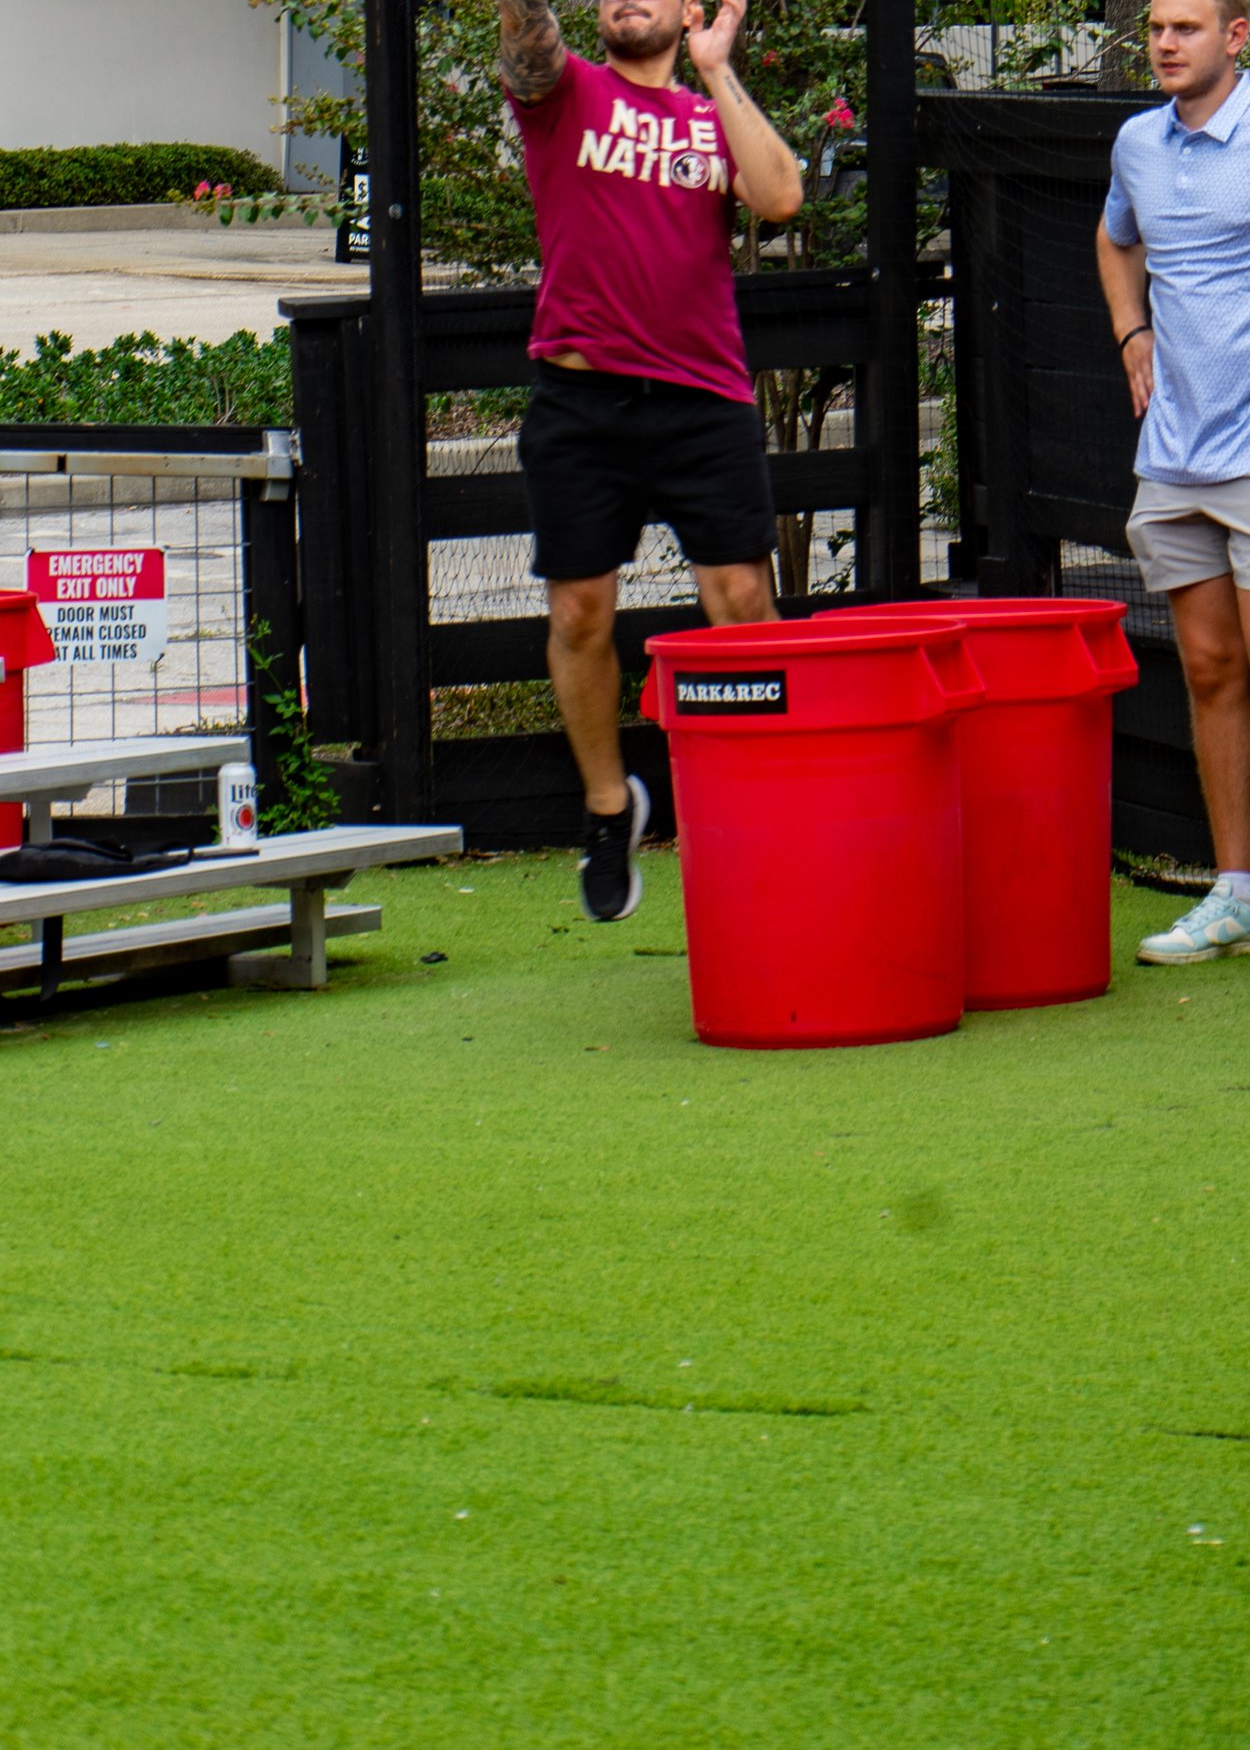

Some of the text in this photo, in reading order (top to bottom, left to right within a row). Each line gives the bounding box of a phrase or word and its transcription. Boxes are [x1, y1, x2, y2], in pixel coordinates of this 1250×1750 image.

[608, 98, 719, 153] NOLE
[48, 552, 145, 576] EMERGENCY
[56, 576, 137, 599] EXIT ONLY
[57, 605, 135, 623] DOOR MUST
[98, 624, 147, 640] CLOSED
[54, 643, 138, 662] AT ALL TIMES
[677, 681, 781, 703] PARK&REC
[231, 783, 260, 804] Lite
